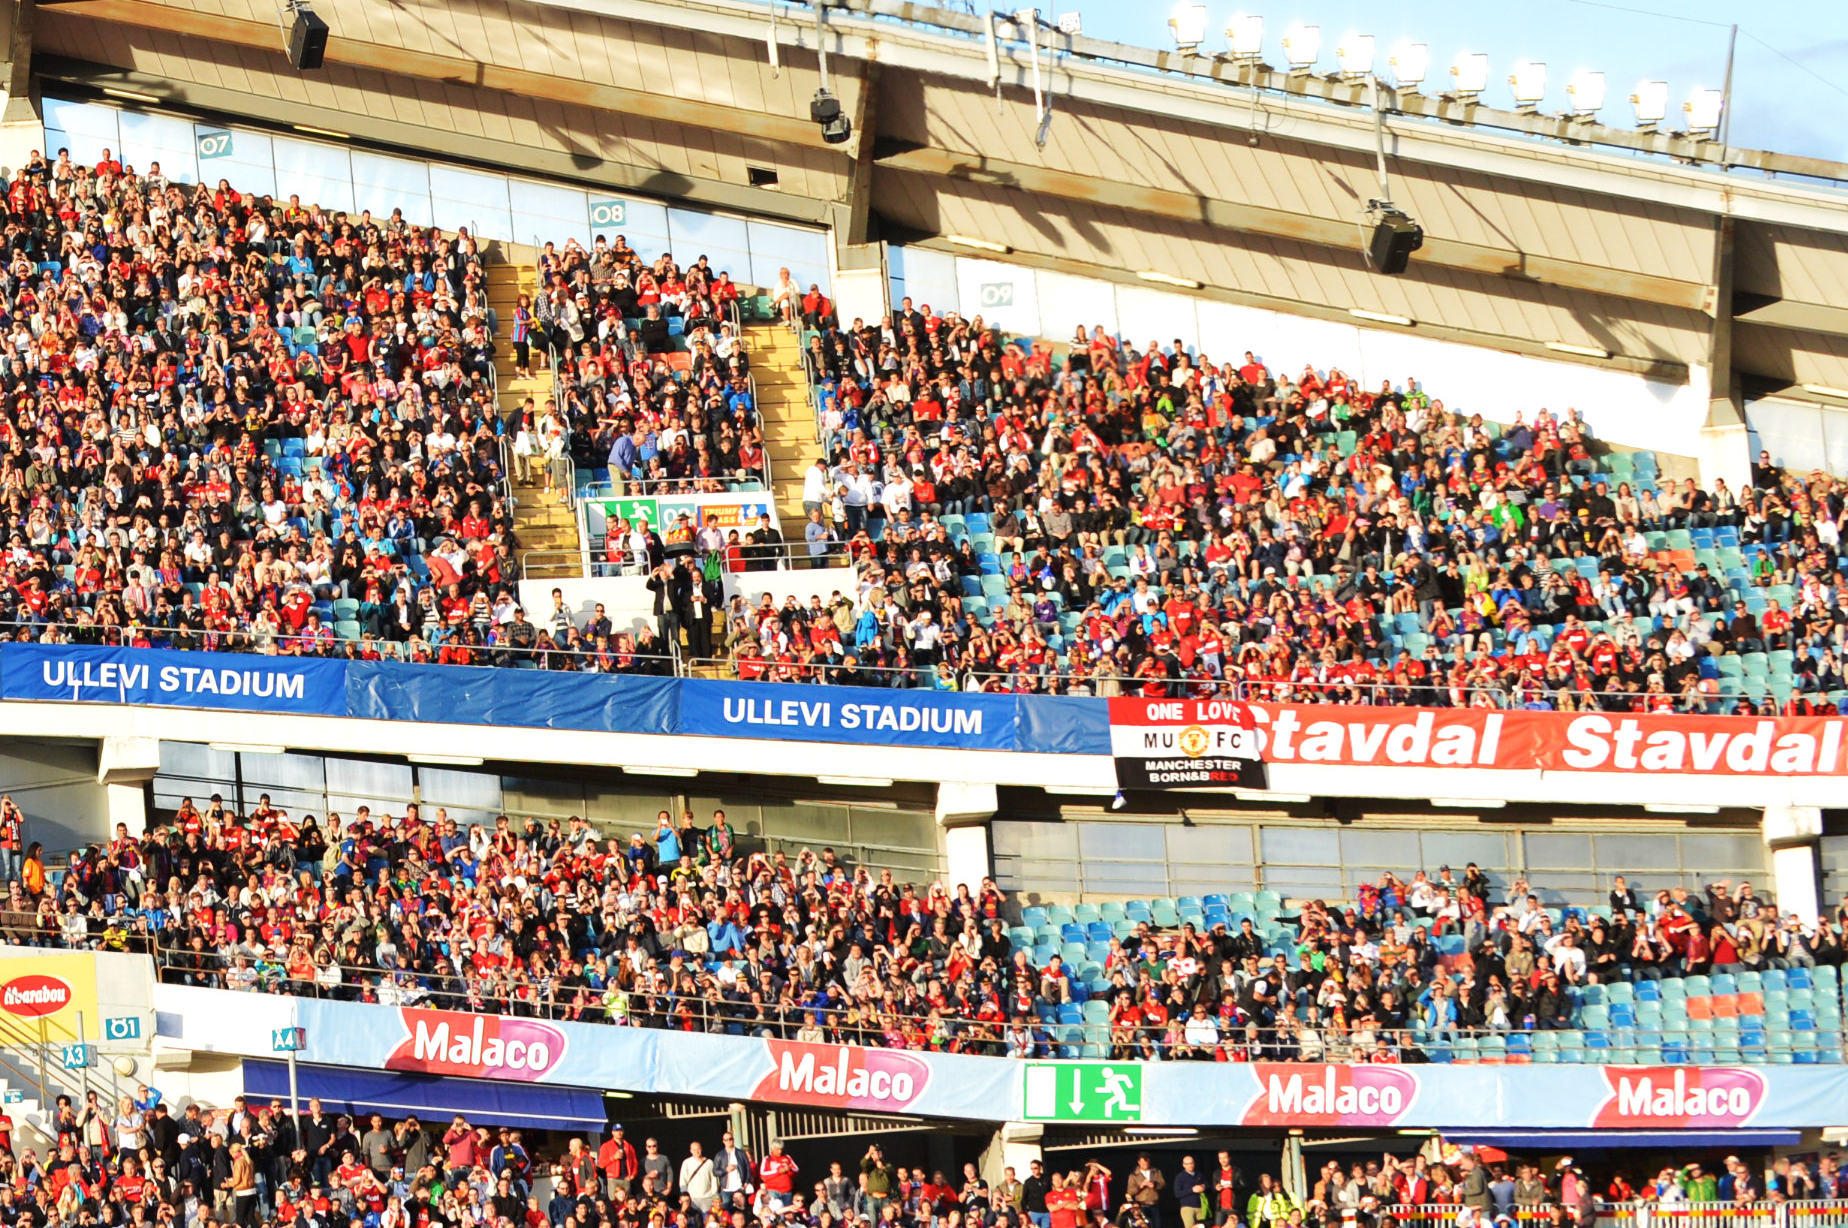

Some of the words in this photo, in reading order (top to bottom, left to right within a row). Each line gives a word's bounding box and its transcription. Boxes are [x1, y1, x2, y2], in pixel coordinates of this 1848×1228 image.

[43, 660, 149, 690] ULLEVI
[159, 666, 304, 699] STADIUM
[723, 697, 831, 727] ULLEVI
[840, 703, 983, 735] STADIUM
[1146, 702, 1184, 721] ONE
[1197, 702, 1241, 723] LOVE
[1562, 714, 1844, 773] Stavdal
[1145, 760, 1242, 771] MANCHESTER
[4, 984, 66, 1006] Marabou
[110, 1018, 136, 1038] Ö1
[274, 1028, 294, 1049] Ä4
[414, 1016, 549, 1071] Malaco
[64, 1045, 85, 1067] Ä3
[779, 1046, 914, 1102] Malaco
[1268, 1065, 1402, 1115] Malaco
[1618, 1068, 1751, 1117] Malaco
